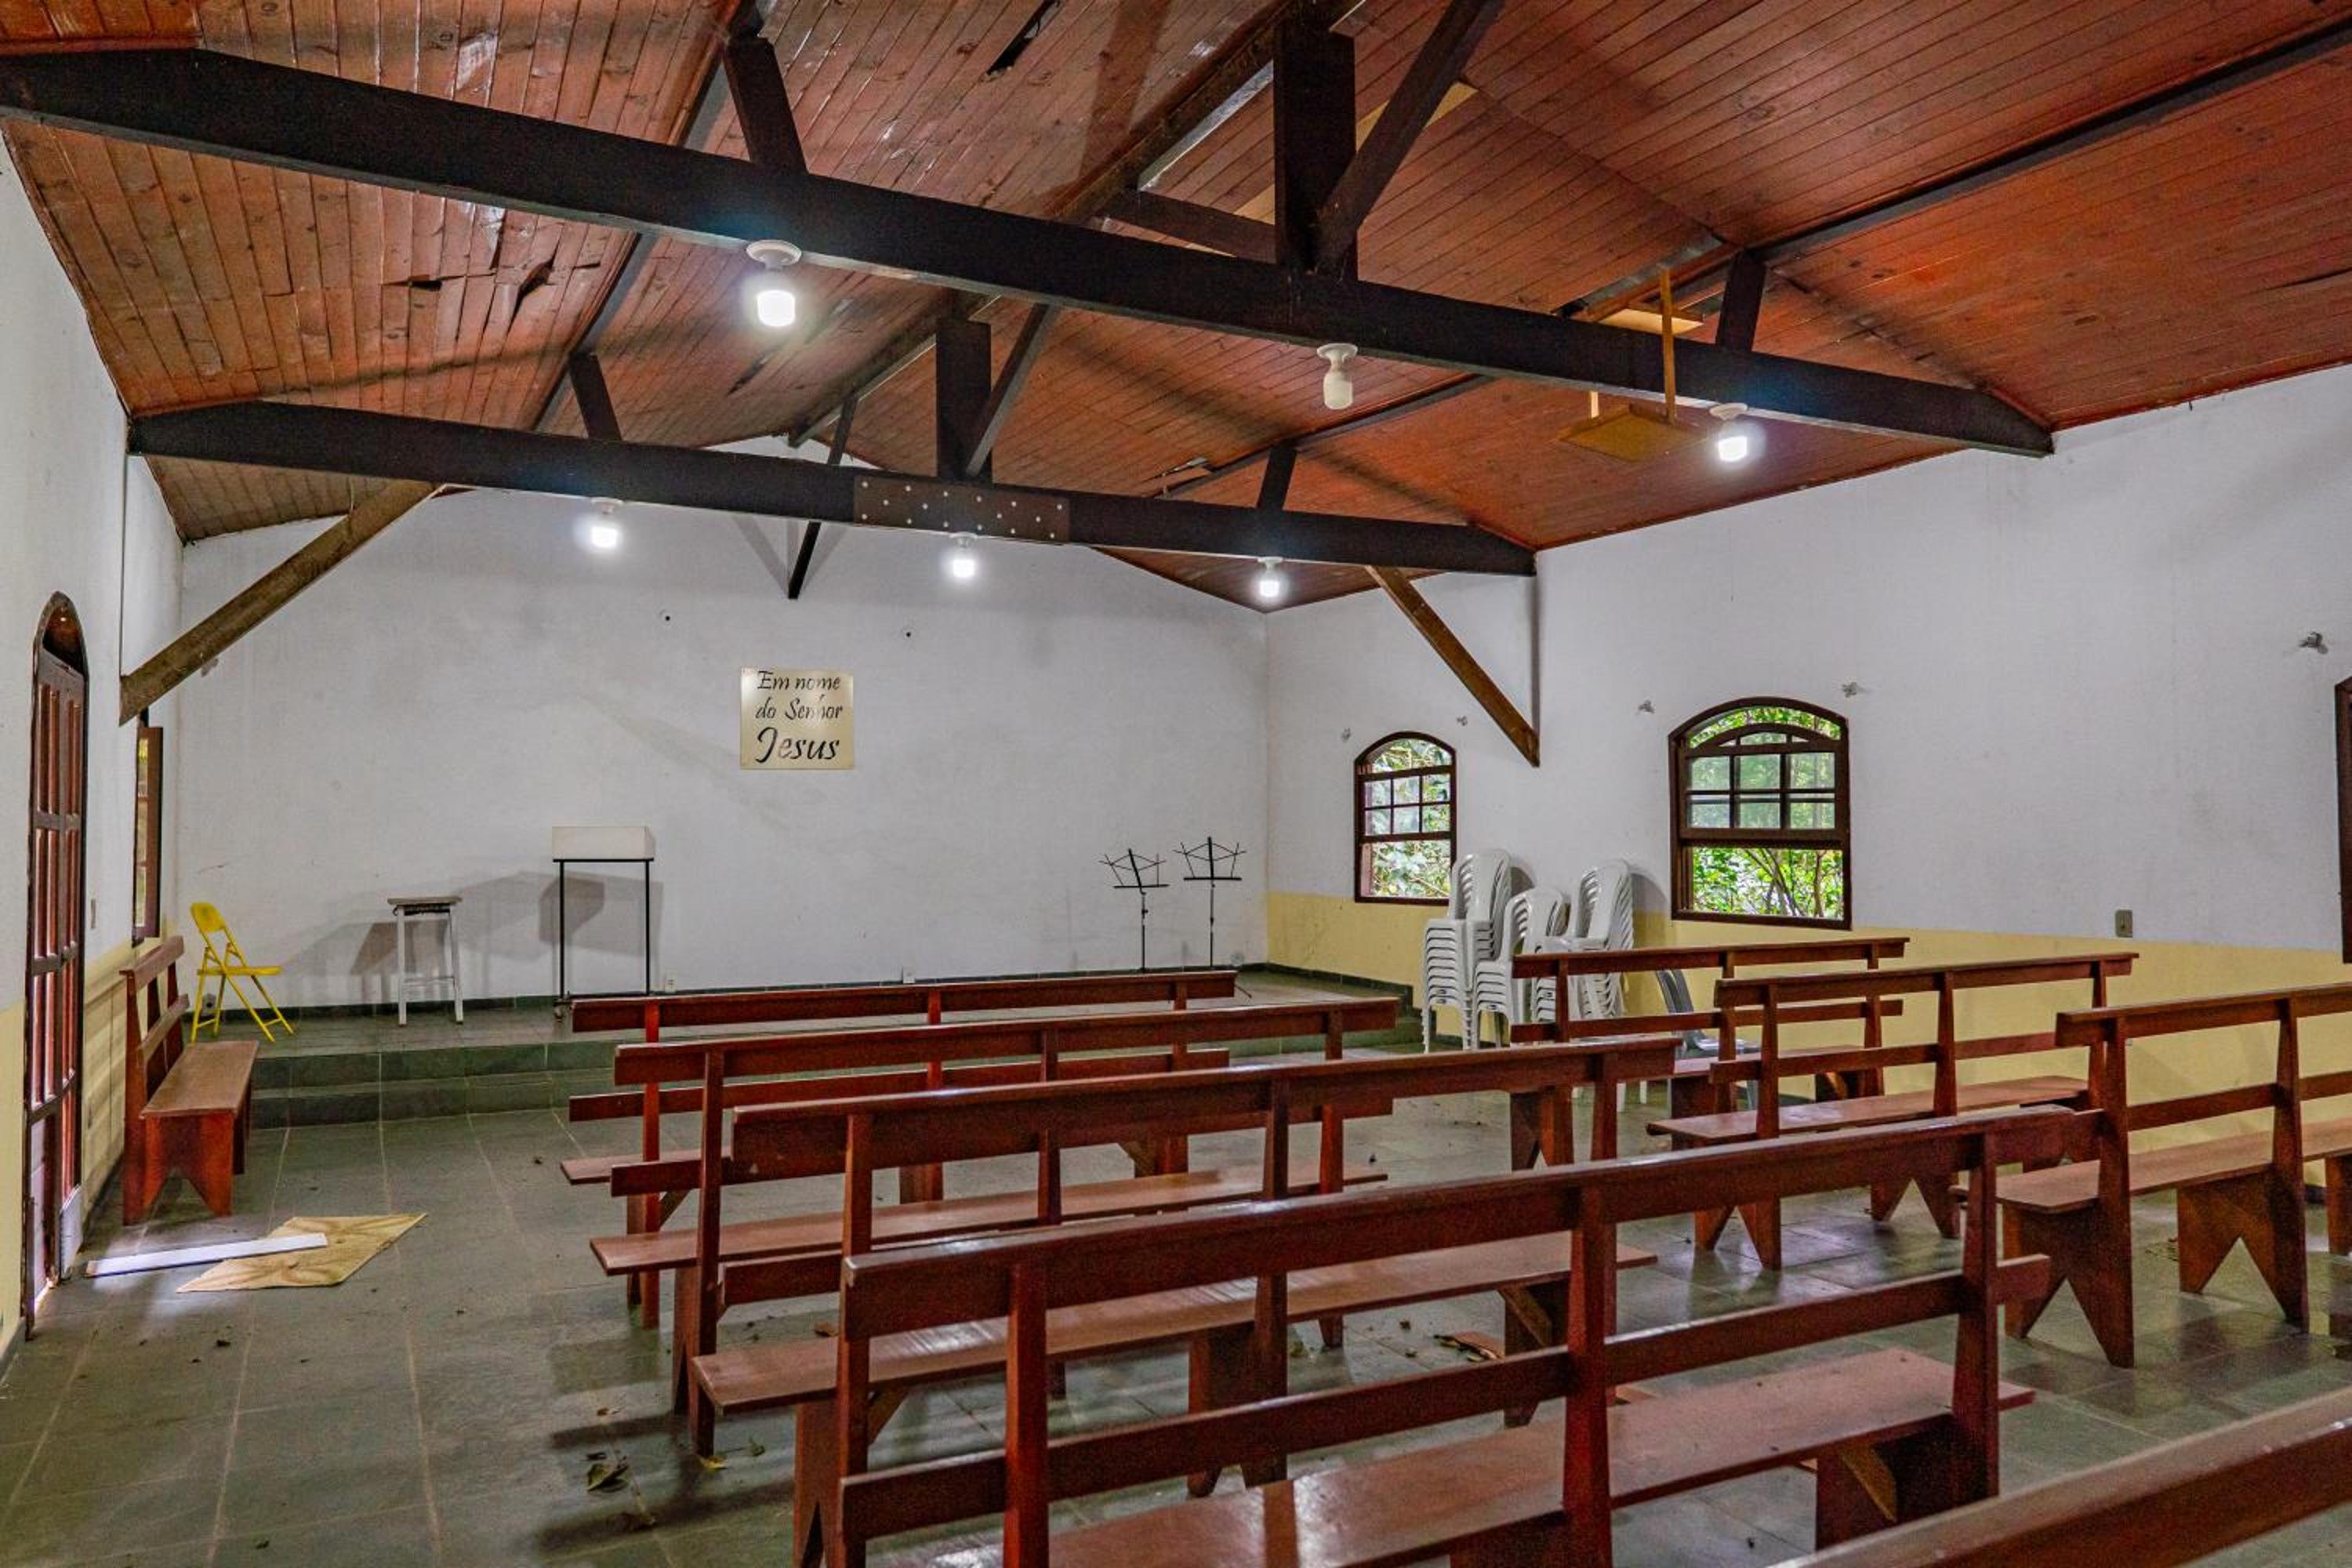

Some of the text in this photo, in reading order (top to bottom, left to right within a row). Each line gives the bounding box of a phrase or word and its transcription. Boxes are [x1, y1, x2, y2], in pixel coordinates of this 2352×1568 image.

[757, 670, 840, 691] Em nome
[755, 696, 777, 719] do
[755, 726, 840, 764] Jesus
